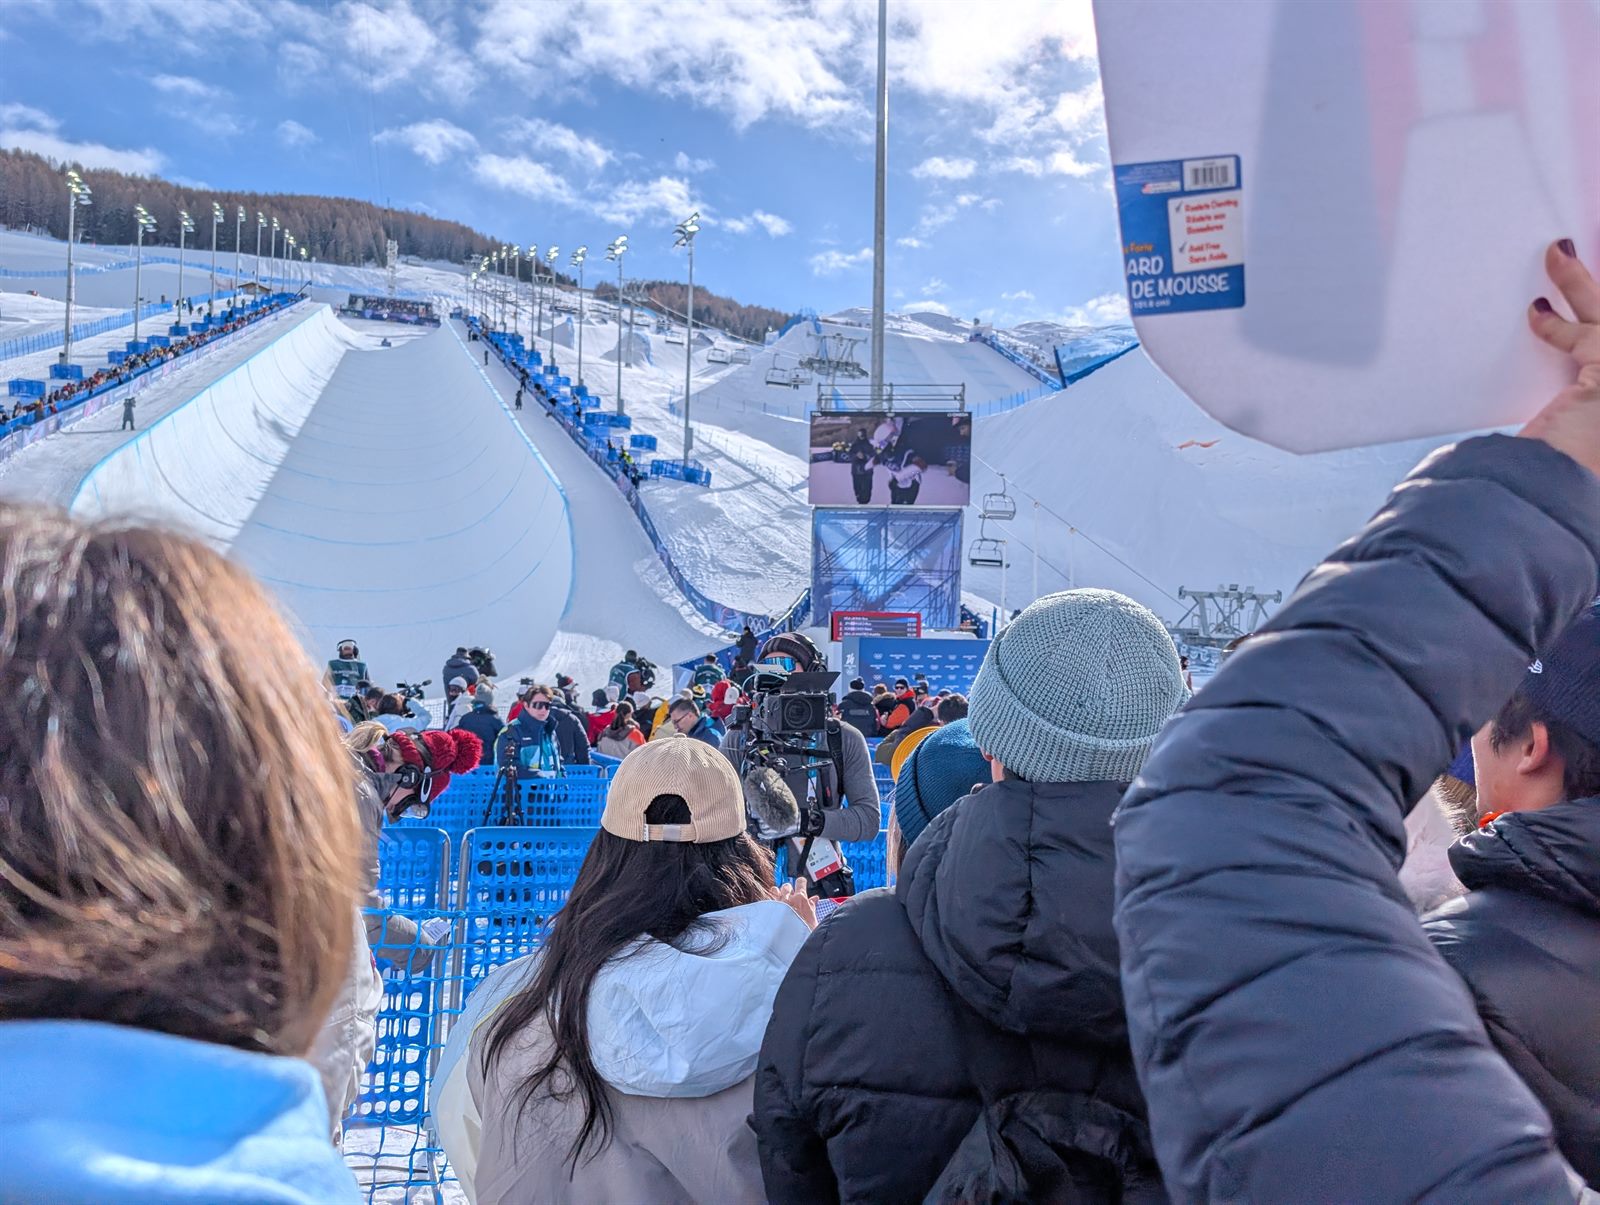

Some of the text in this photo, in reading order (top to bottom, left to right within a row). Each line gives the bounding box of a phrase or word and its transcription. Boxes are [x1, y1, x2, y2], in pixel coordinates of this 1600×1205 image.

[1127, 256, 1163, 276] ARD
[1132, 273, 1229, 298] DE MOUSSE
